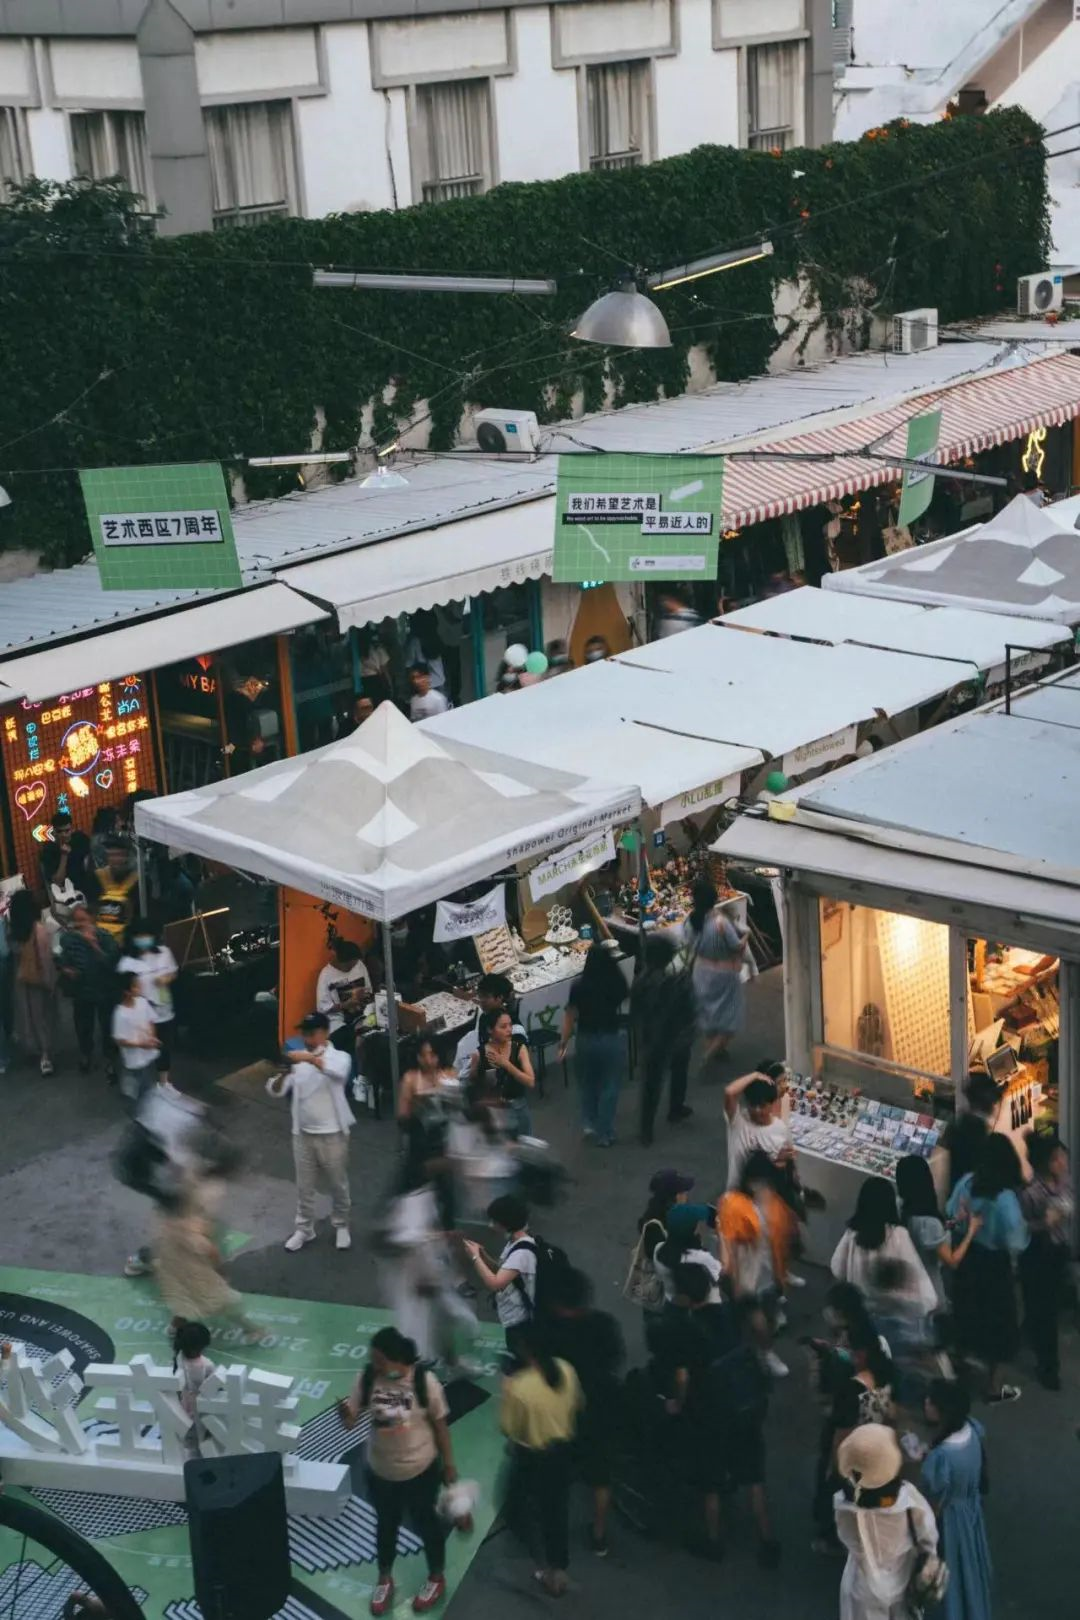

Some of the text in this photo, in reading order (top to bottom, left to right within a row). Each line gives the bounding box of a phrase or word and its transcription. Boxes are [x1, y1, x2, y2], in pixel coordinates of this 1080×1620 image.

[571, 497, 657, 511] 我们希望艺术是
[103, 516, 217, 539] 艺术西区7周年
[645, 516, 708, 529] 平易近人的
[557, 816, 598, 838] Original
[600, 804, 632, 823] Market
[20, 1314, 49, 1327] AND
[48, 1323, 102, 1360] SHAPOWEI
